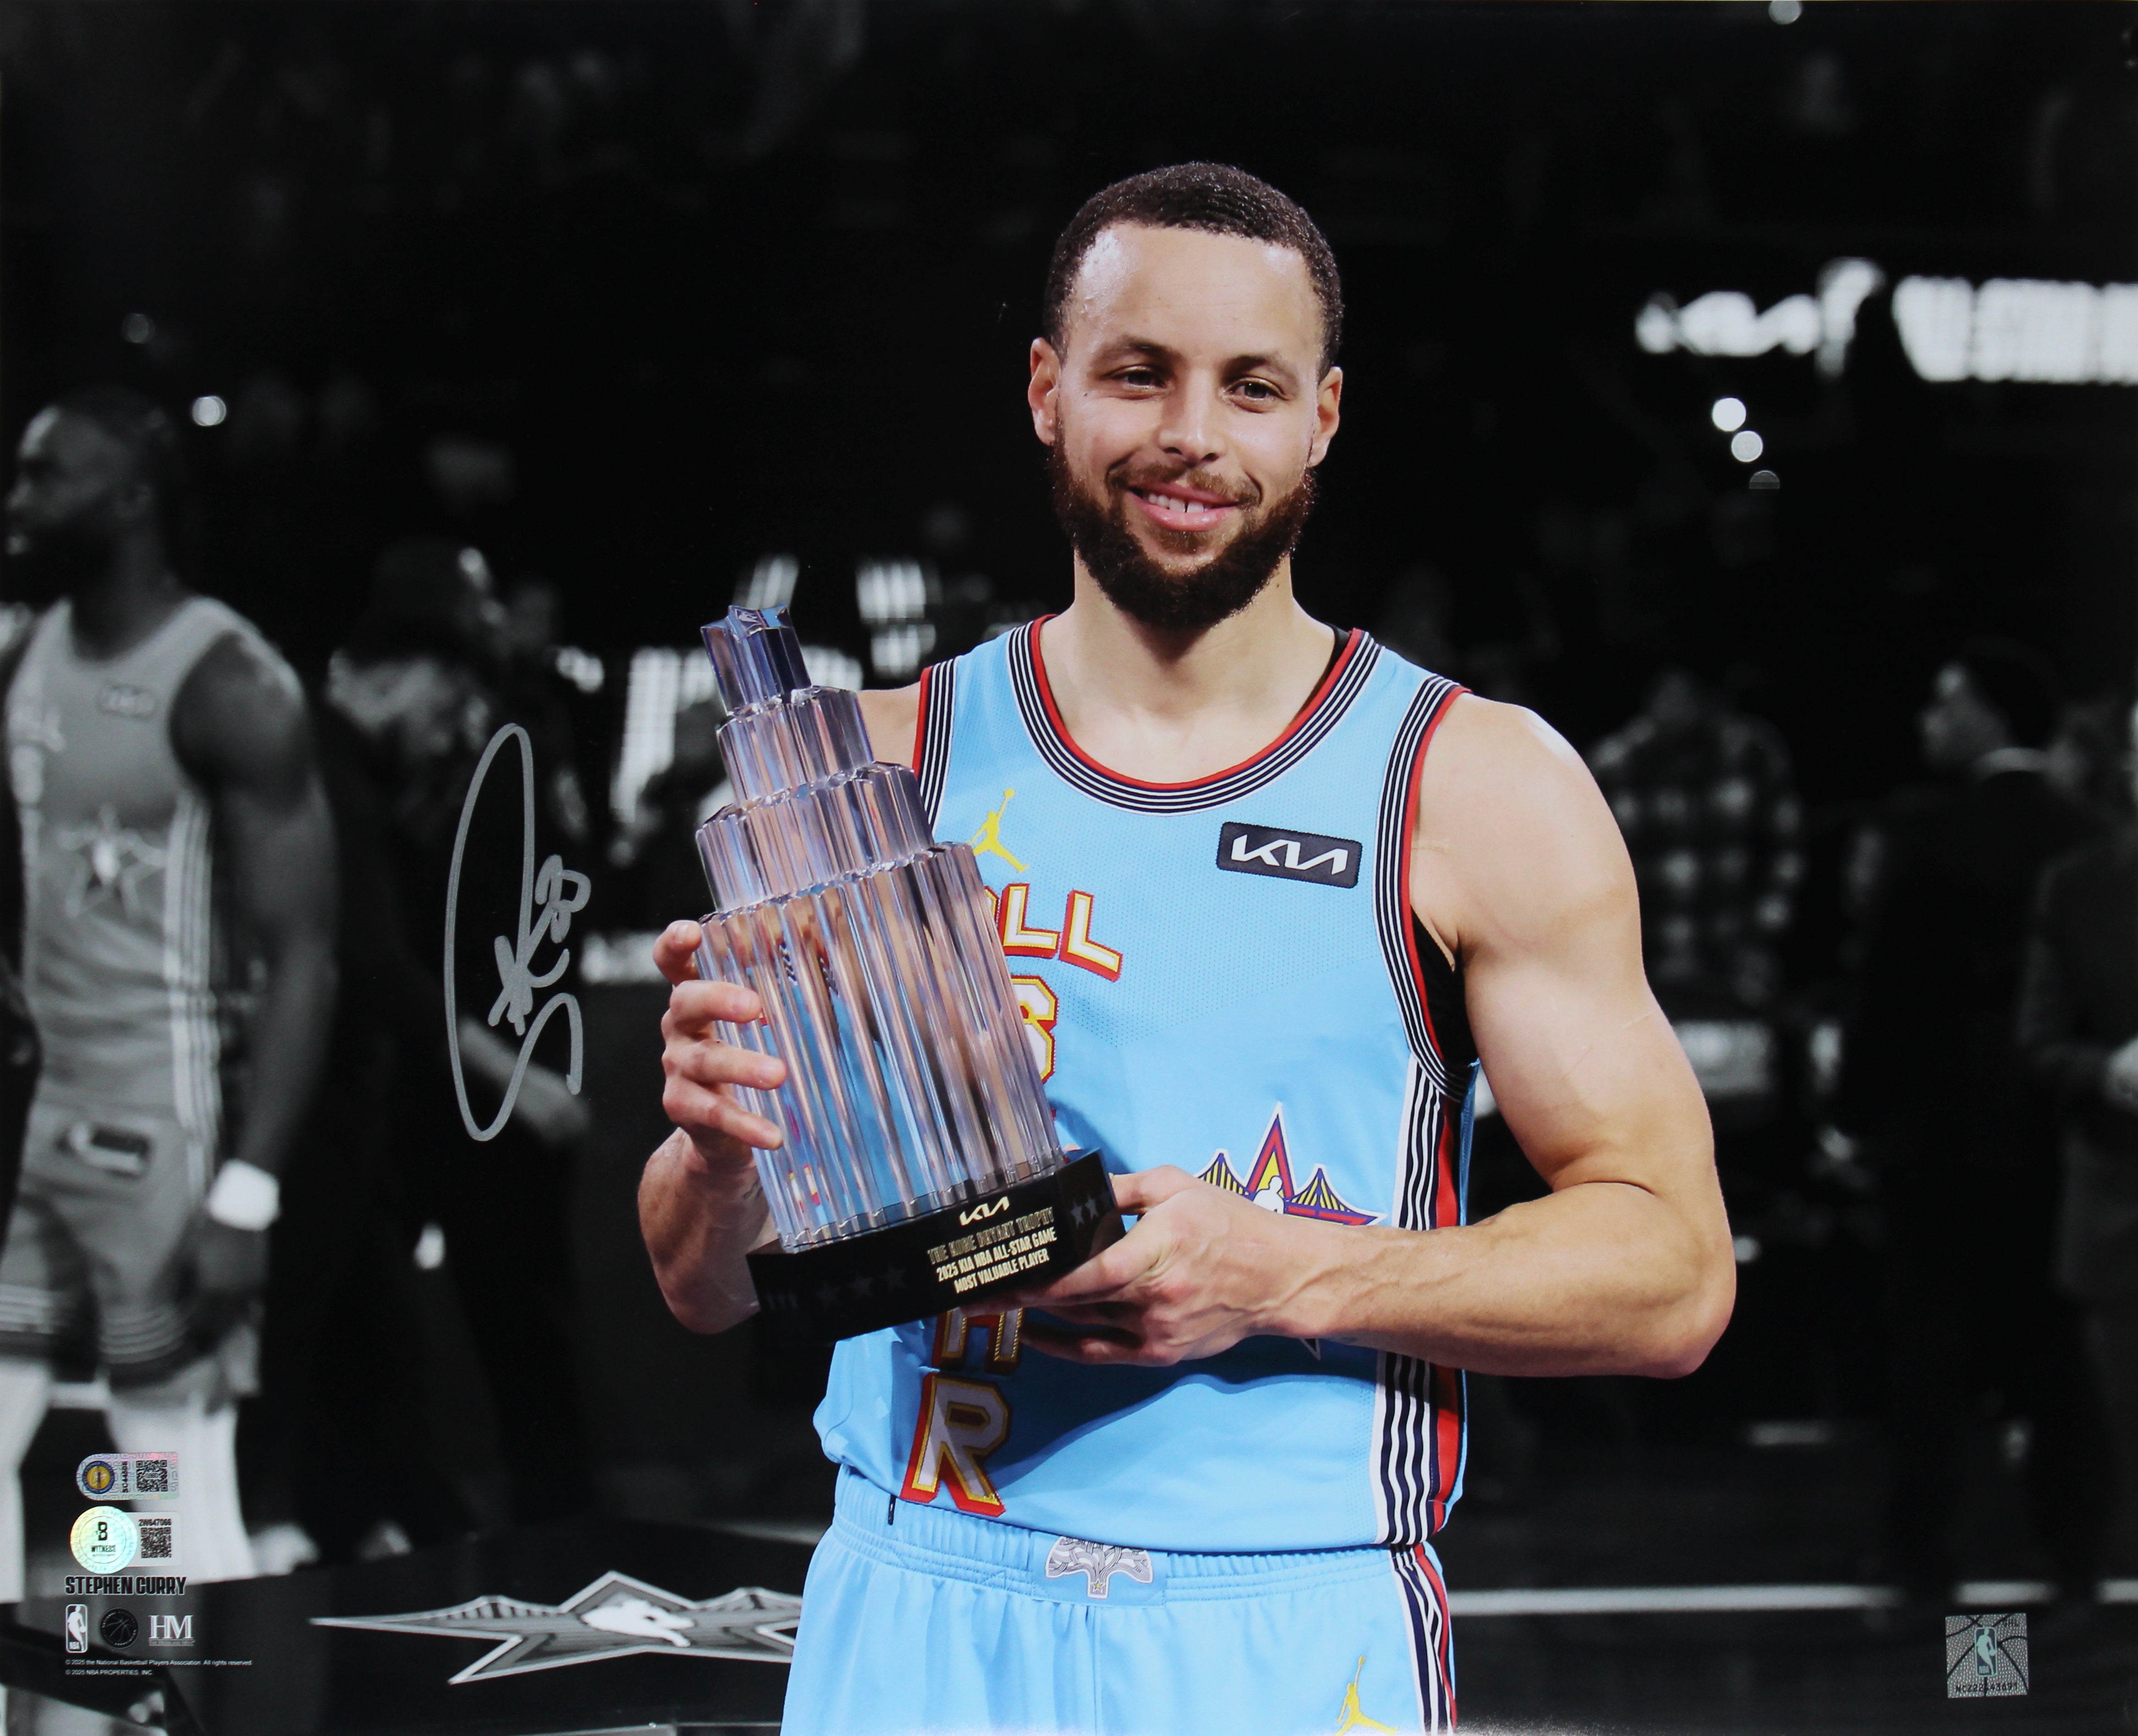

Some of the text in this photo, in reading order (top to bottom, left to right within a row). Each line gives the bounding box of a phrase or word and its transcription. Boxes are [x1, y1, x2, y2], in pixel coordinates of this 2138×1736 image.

[1231, 834, 1349, 875] KIA
[959, 1196, 1010, 1226] KIA
[927, 1206, 1054, 1265] THE KOBE BRYANT TROPHY
[936, 1226, 1057, 1282] 2025 KIA NBA ALL-STAR GAME
[954, 1248, 1050, 1294] MOST VALUABLE PLAYER
